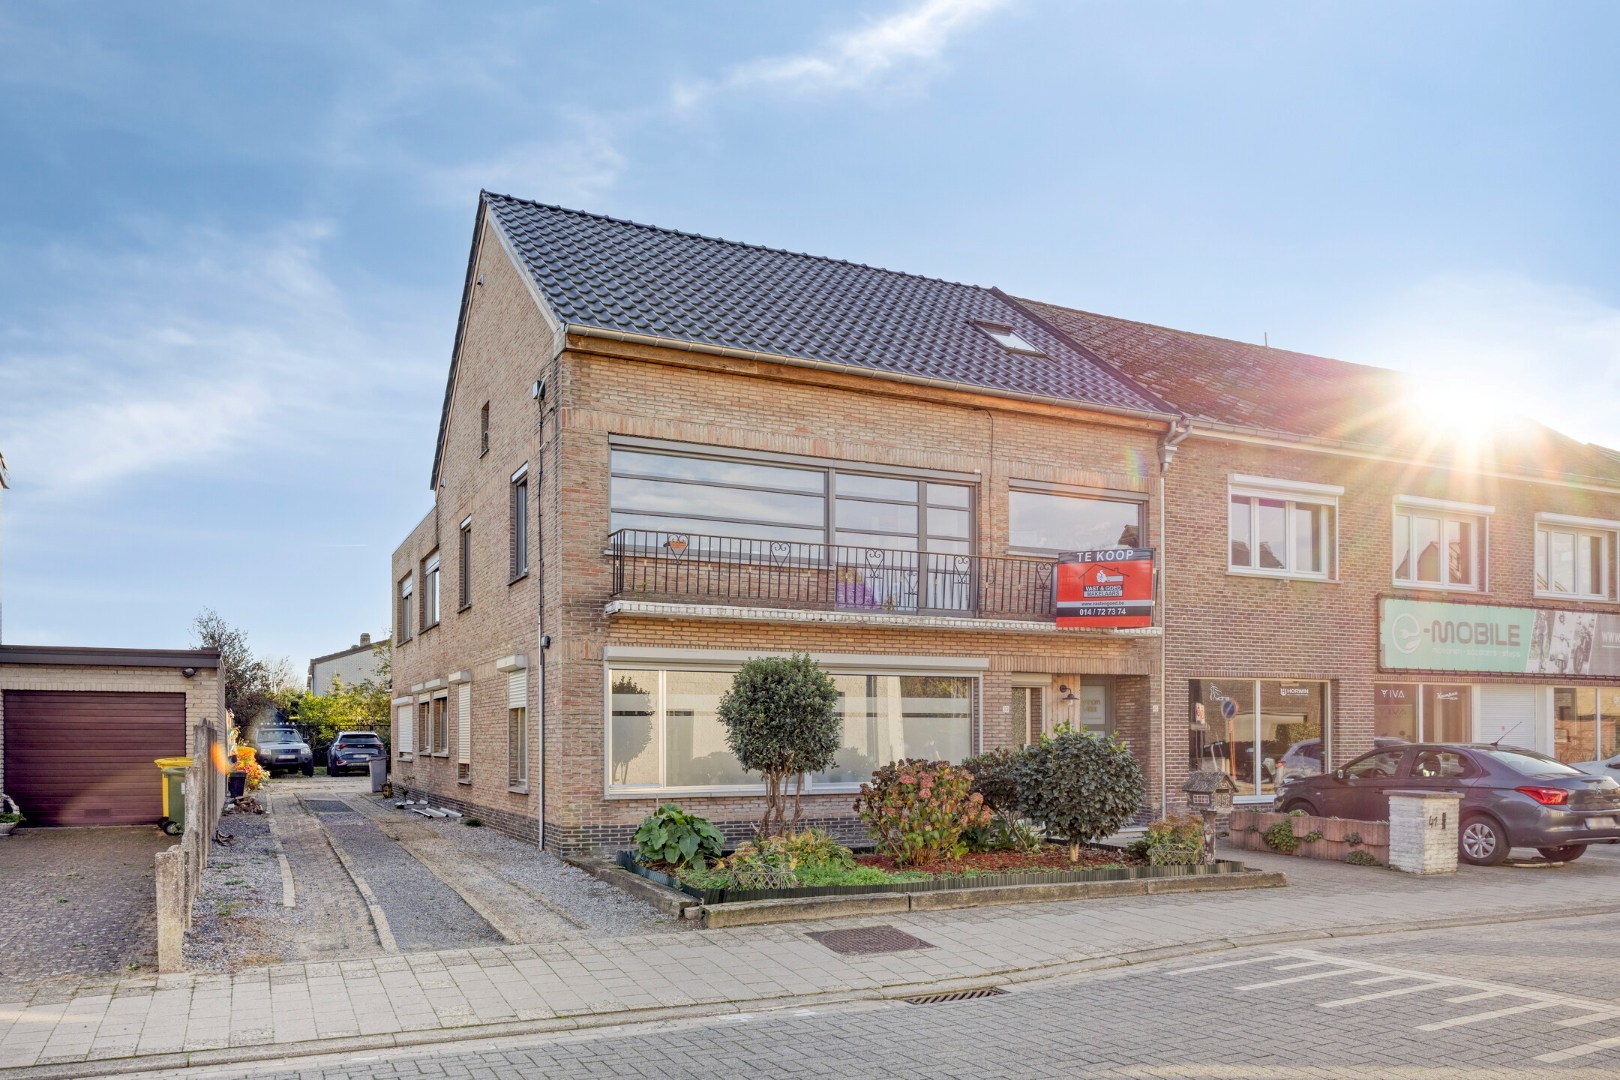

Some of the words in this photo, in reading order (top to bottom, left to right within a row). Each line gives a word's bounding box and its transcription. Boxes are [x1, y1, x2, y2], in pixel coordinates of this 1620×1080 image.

[1077, 552, 1092, 562] TE
[1096, 550, 1134, 561] KOOP
[1079, 608, 1092, 616] 014
[1097, 608, 1105, 616] 72
[1107, 608, 1116, 616] 73
